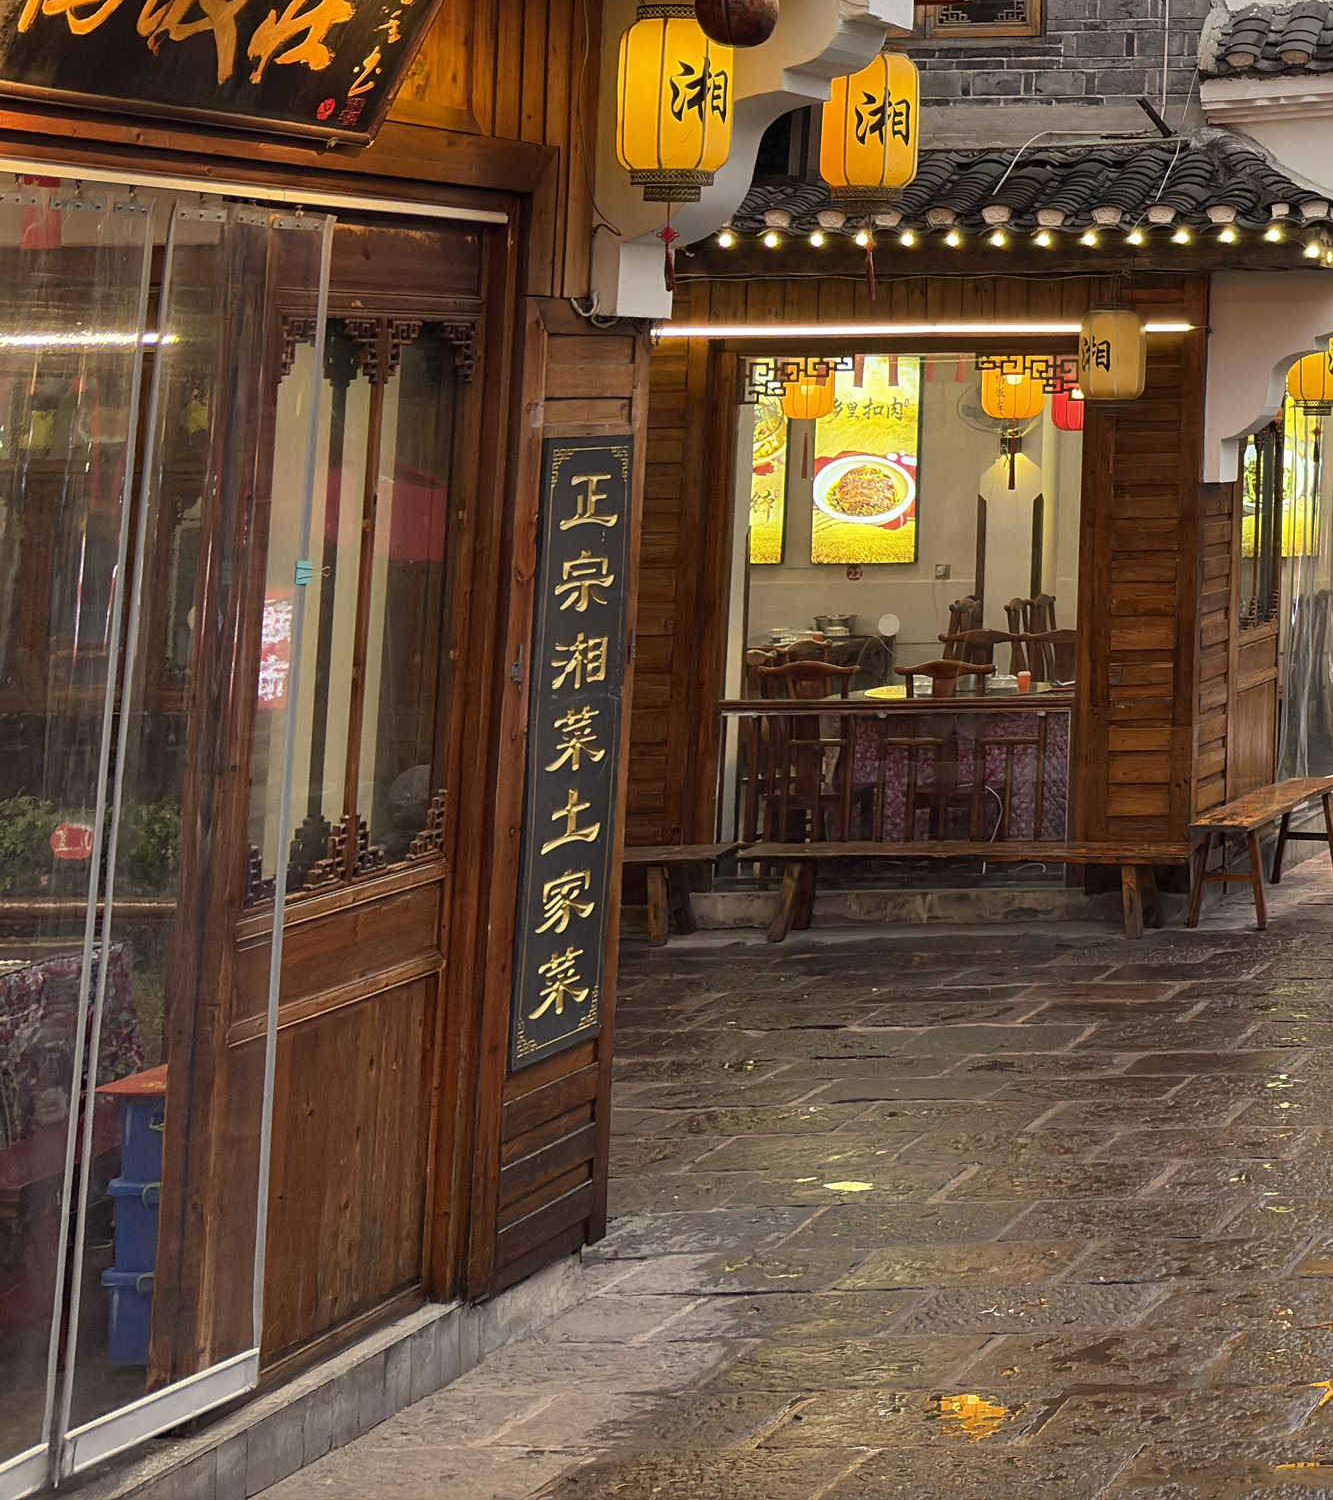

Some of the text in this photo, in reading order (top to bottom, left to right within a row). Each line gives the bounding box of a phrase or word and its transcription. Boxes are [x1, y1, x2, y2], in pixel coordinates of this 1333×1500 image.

[670, 56, 729, 126] 湘
[855, 87, 912, 147] 湘
[1080, 335, 1112, 374] 湘
[528, 472, 619, 1022] 正宗湘菜土家菜
